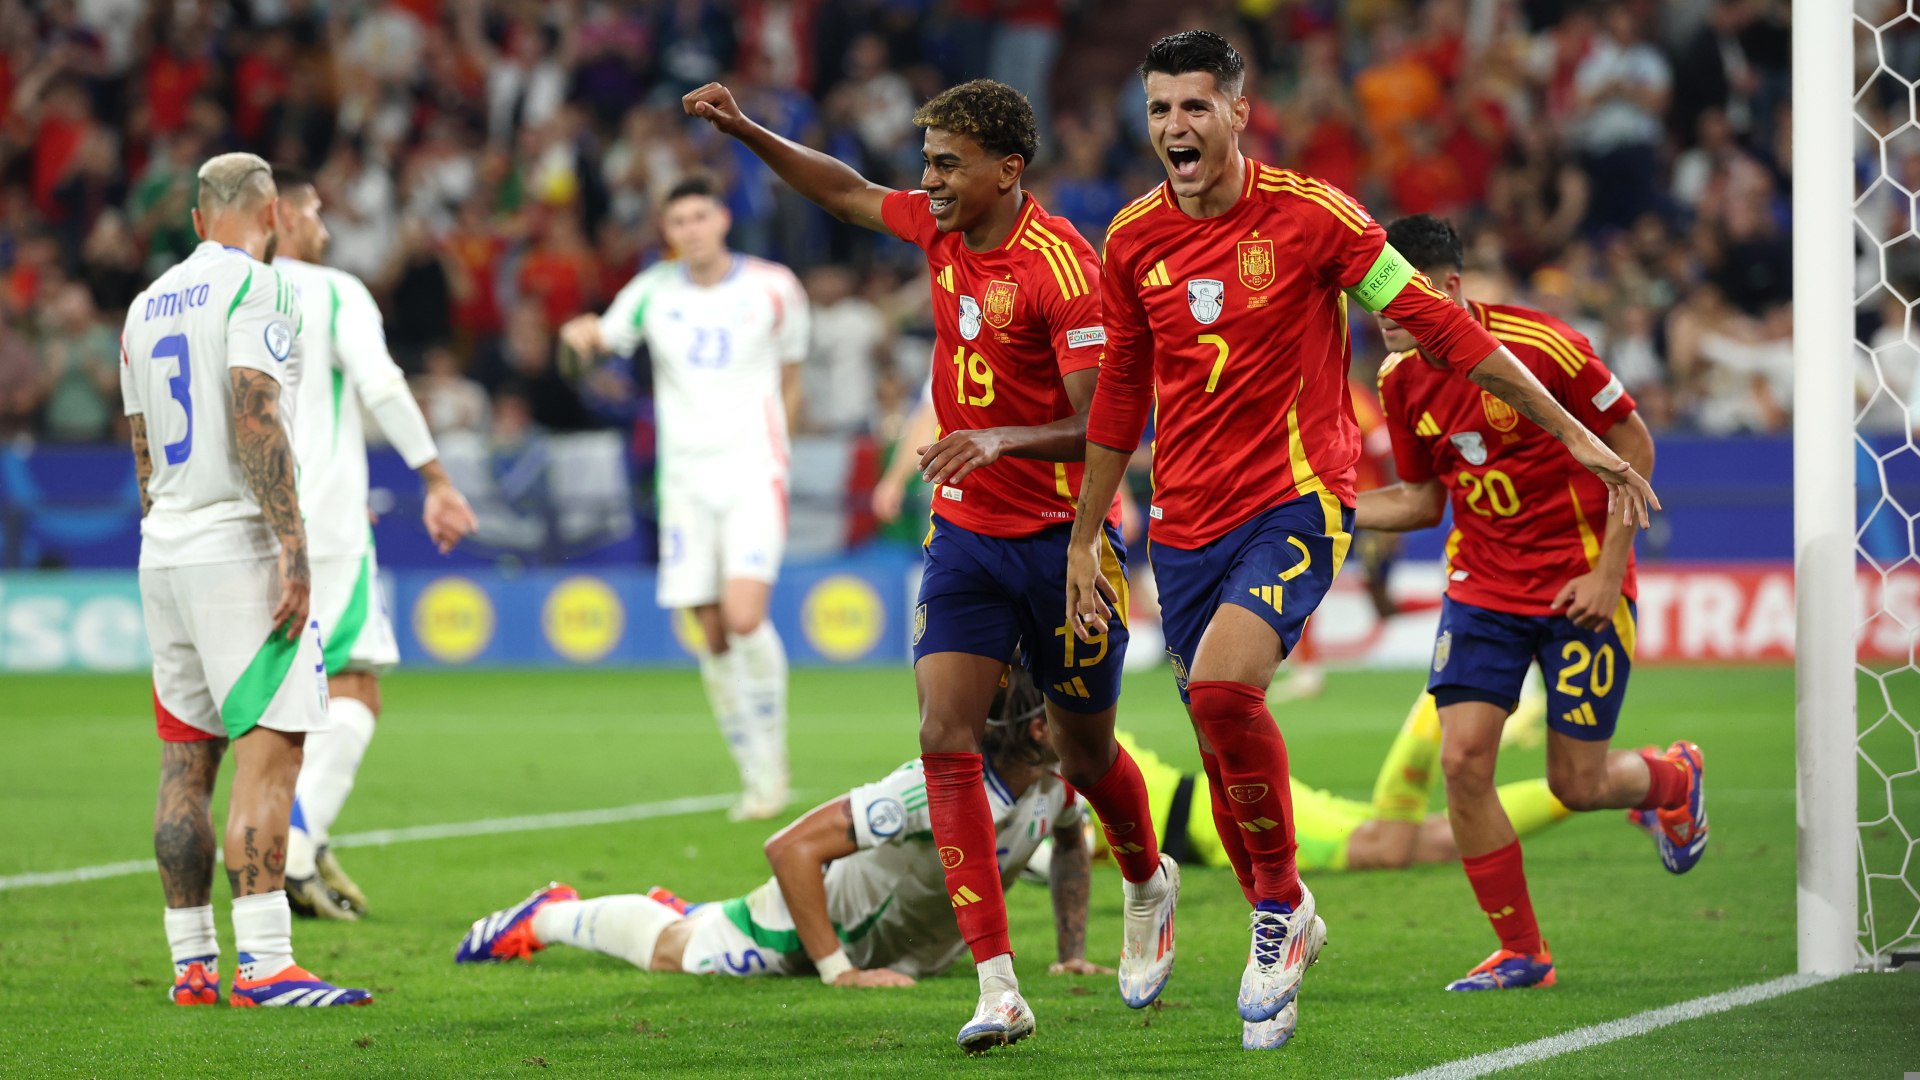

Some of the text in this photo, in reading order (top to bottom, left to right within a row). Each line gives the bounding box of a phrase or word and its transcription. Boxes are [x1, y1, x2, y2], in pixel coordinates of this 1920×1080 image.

[1369, 256, 1399, 291] RESPEC
[953, 345, 995, 407] 19
[1197, 334, 1229, 393] 7
[151, 333, 193, 465] 3
[1458, 470, 1521, 517] 20
[1278, 535, 1312, 582] 7
[1054, 612, 1109, 668] 19
[1634, 573, 1920, 657] TRAS
[1556, 640, 1615, 698] 20
